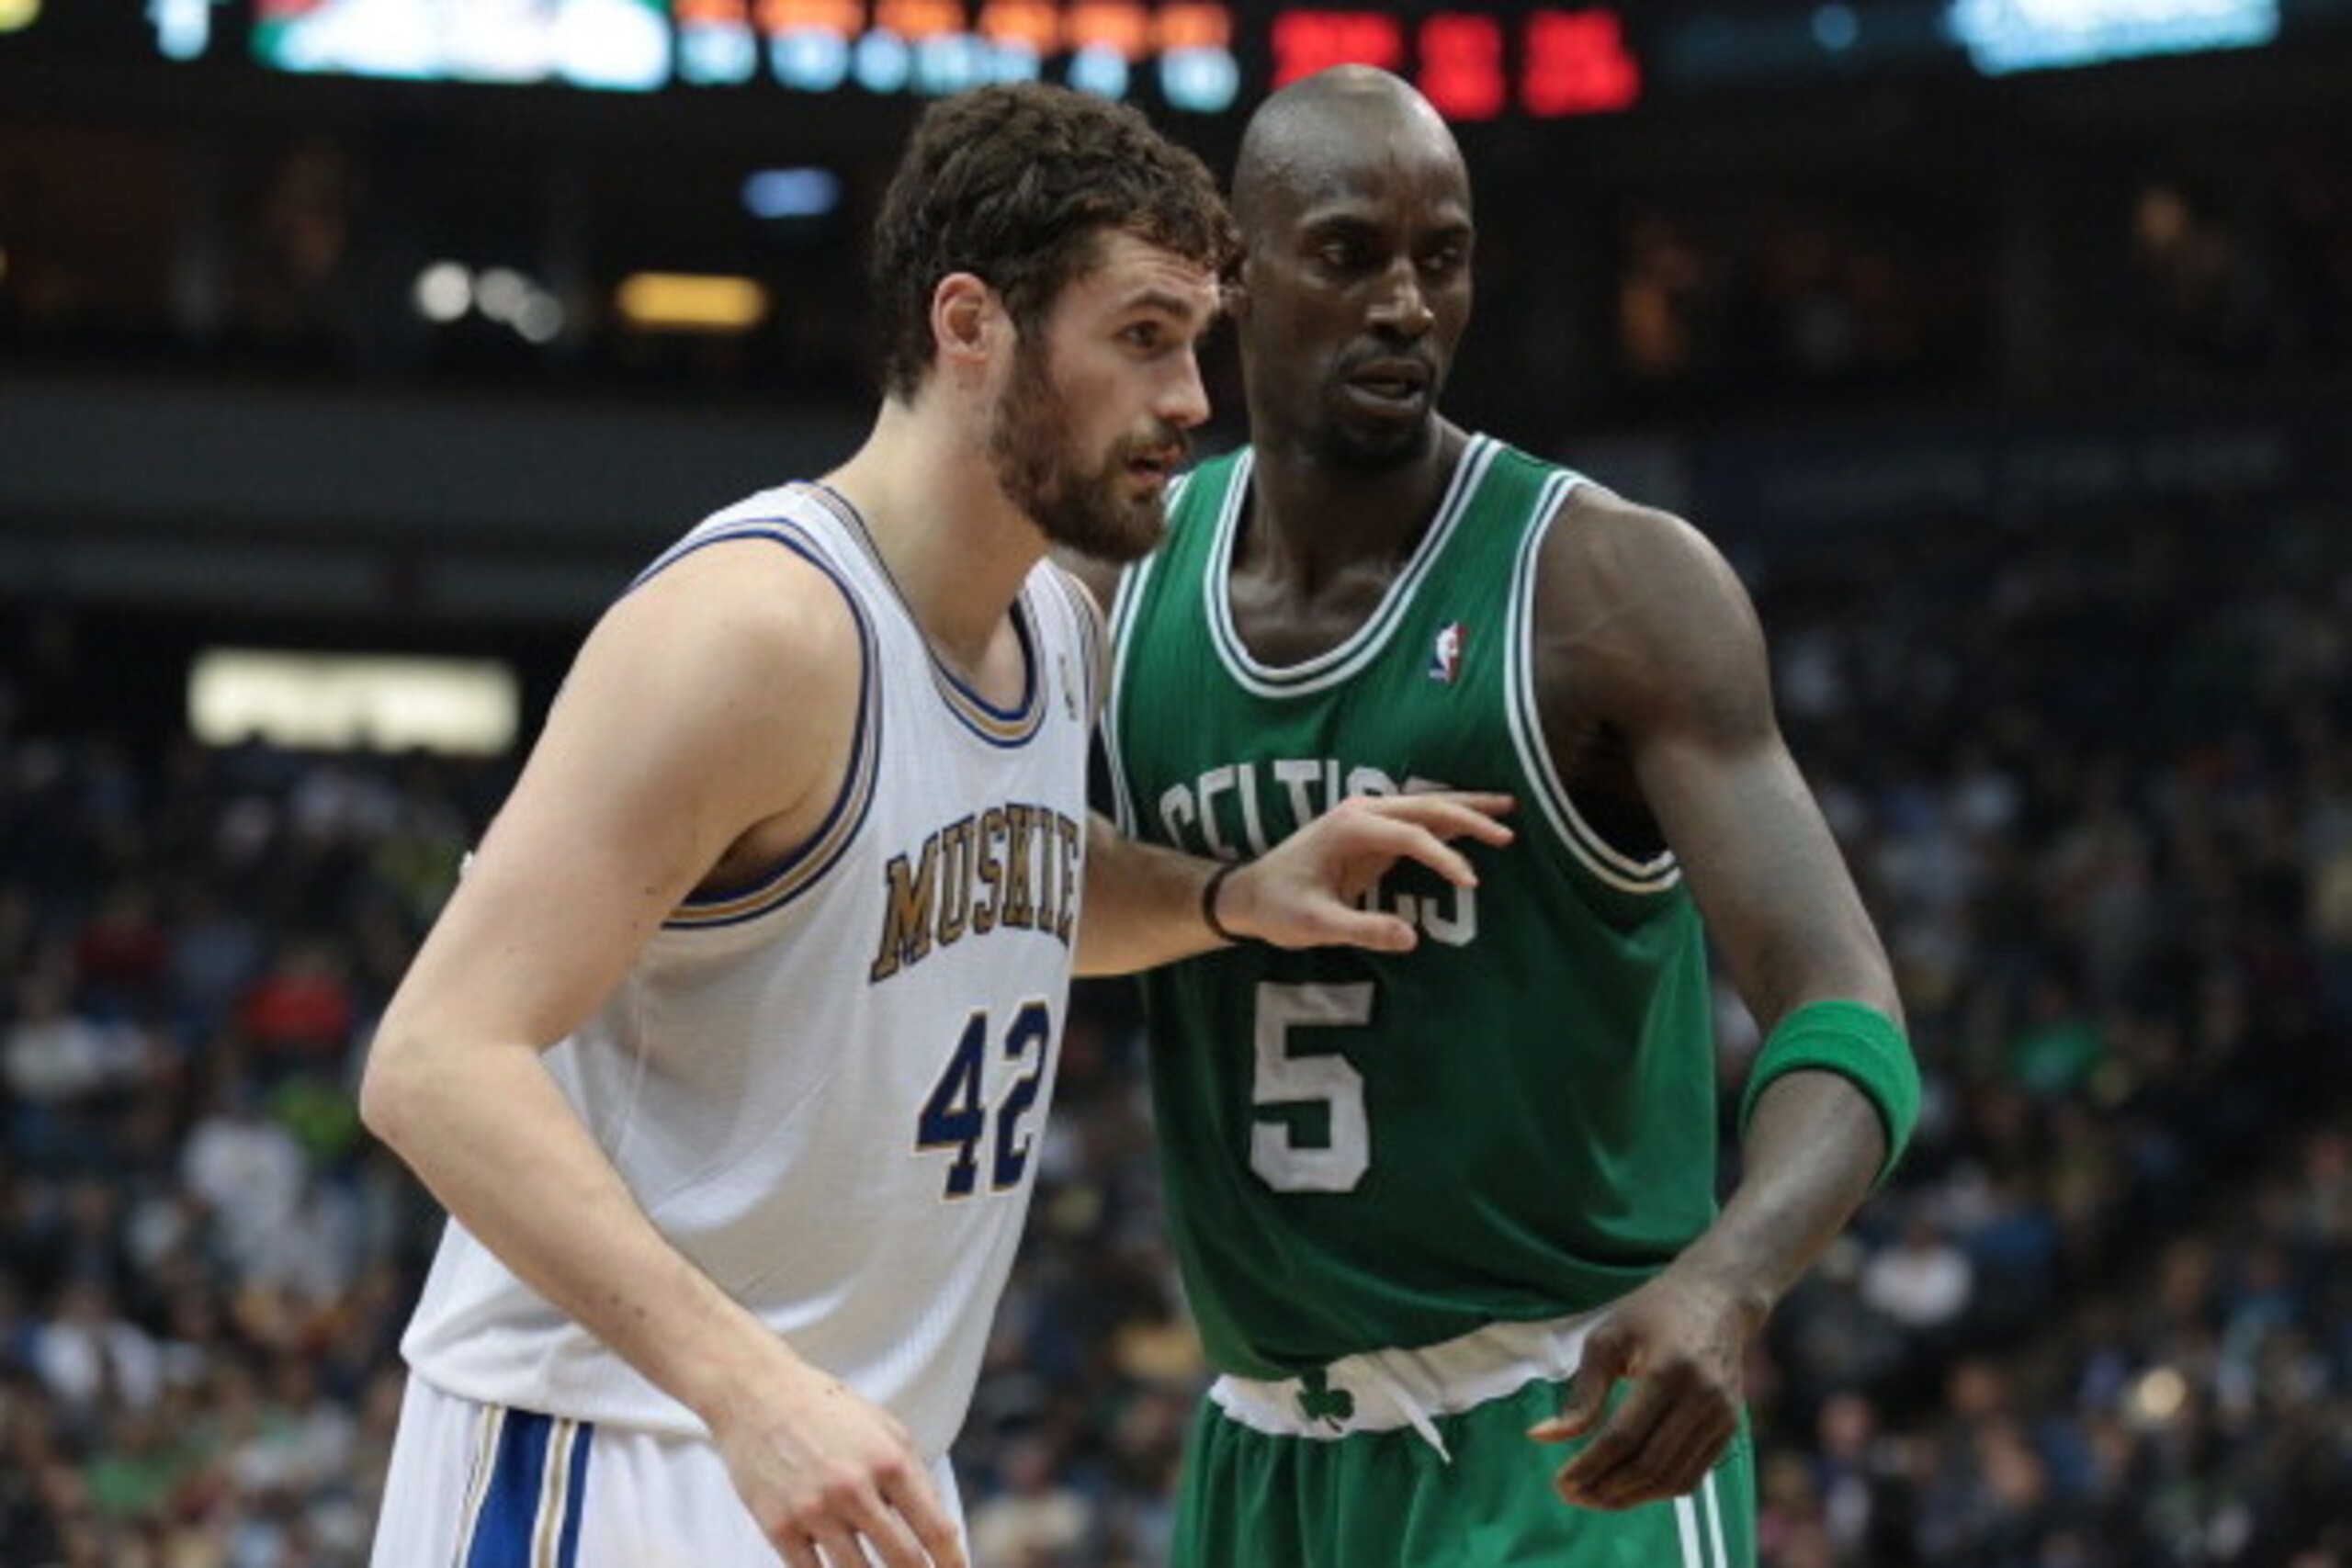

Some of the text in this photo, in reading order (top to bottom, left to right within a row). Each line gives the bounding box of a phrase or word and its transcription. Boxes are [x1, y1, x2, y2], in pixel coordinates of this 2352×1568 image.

[1159, 759, 1476, 947] CELTS
[915, 999, 1050, 1200] 42
[1250, 981, 1374, 1193] 5
